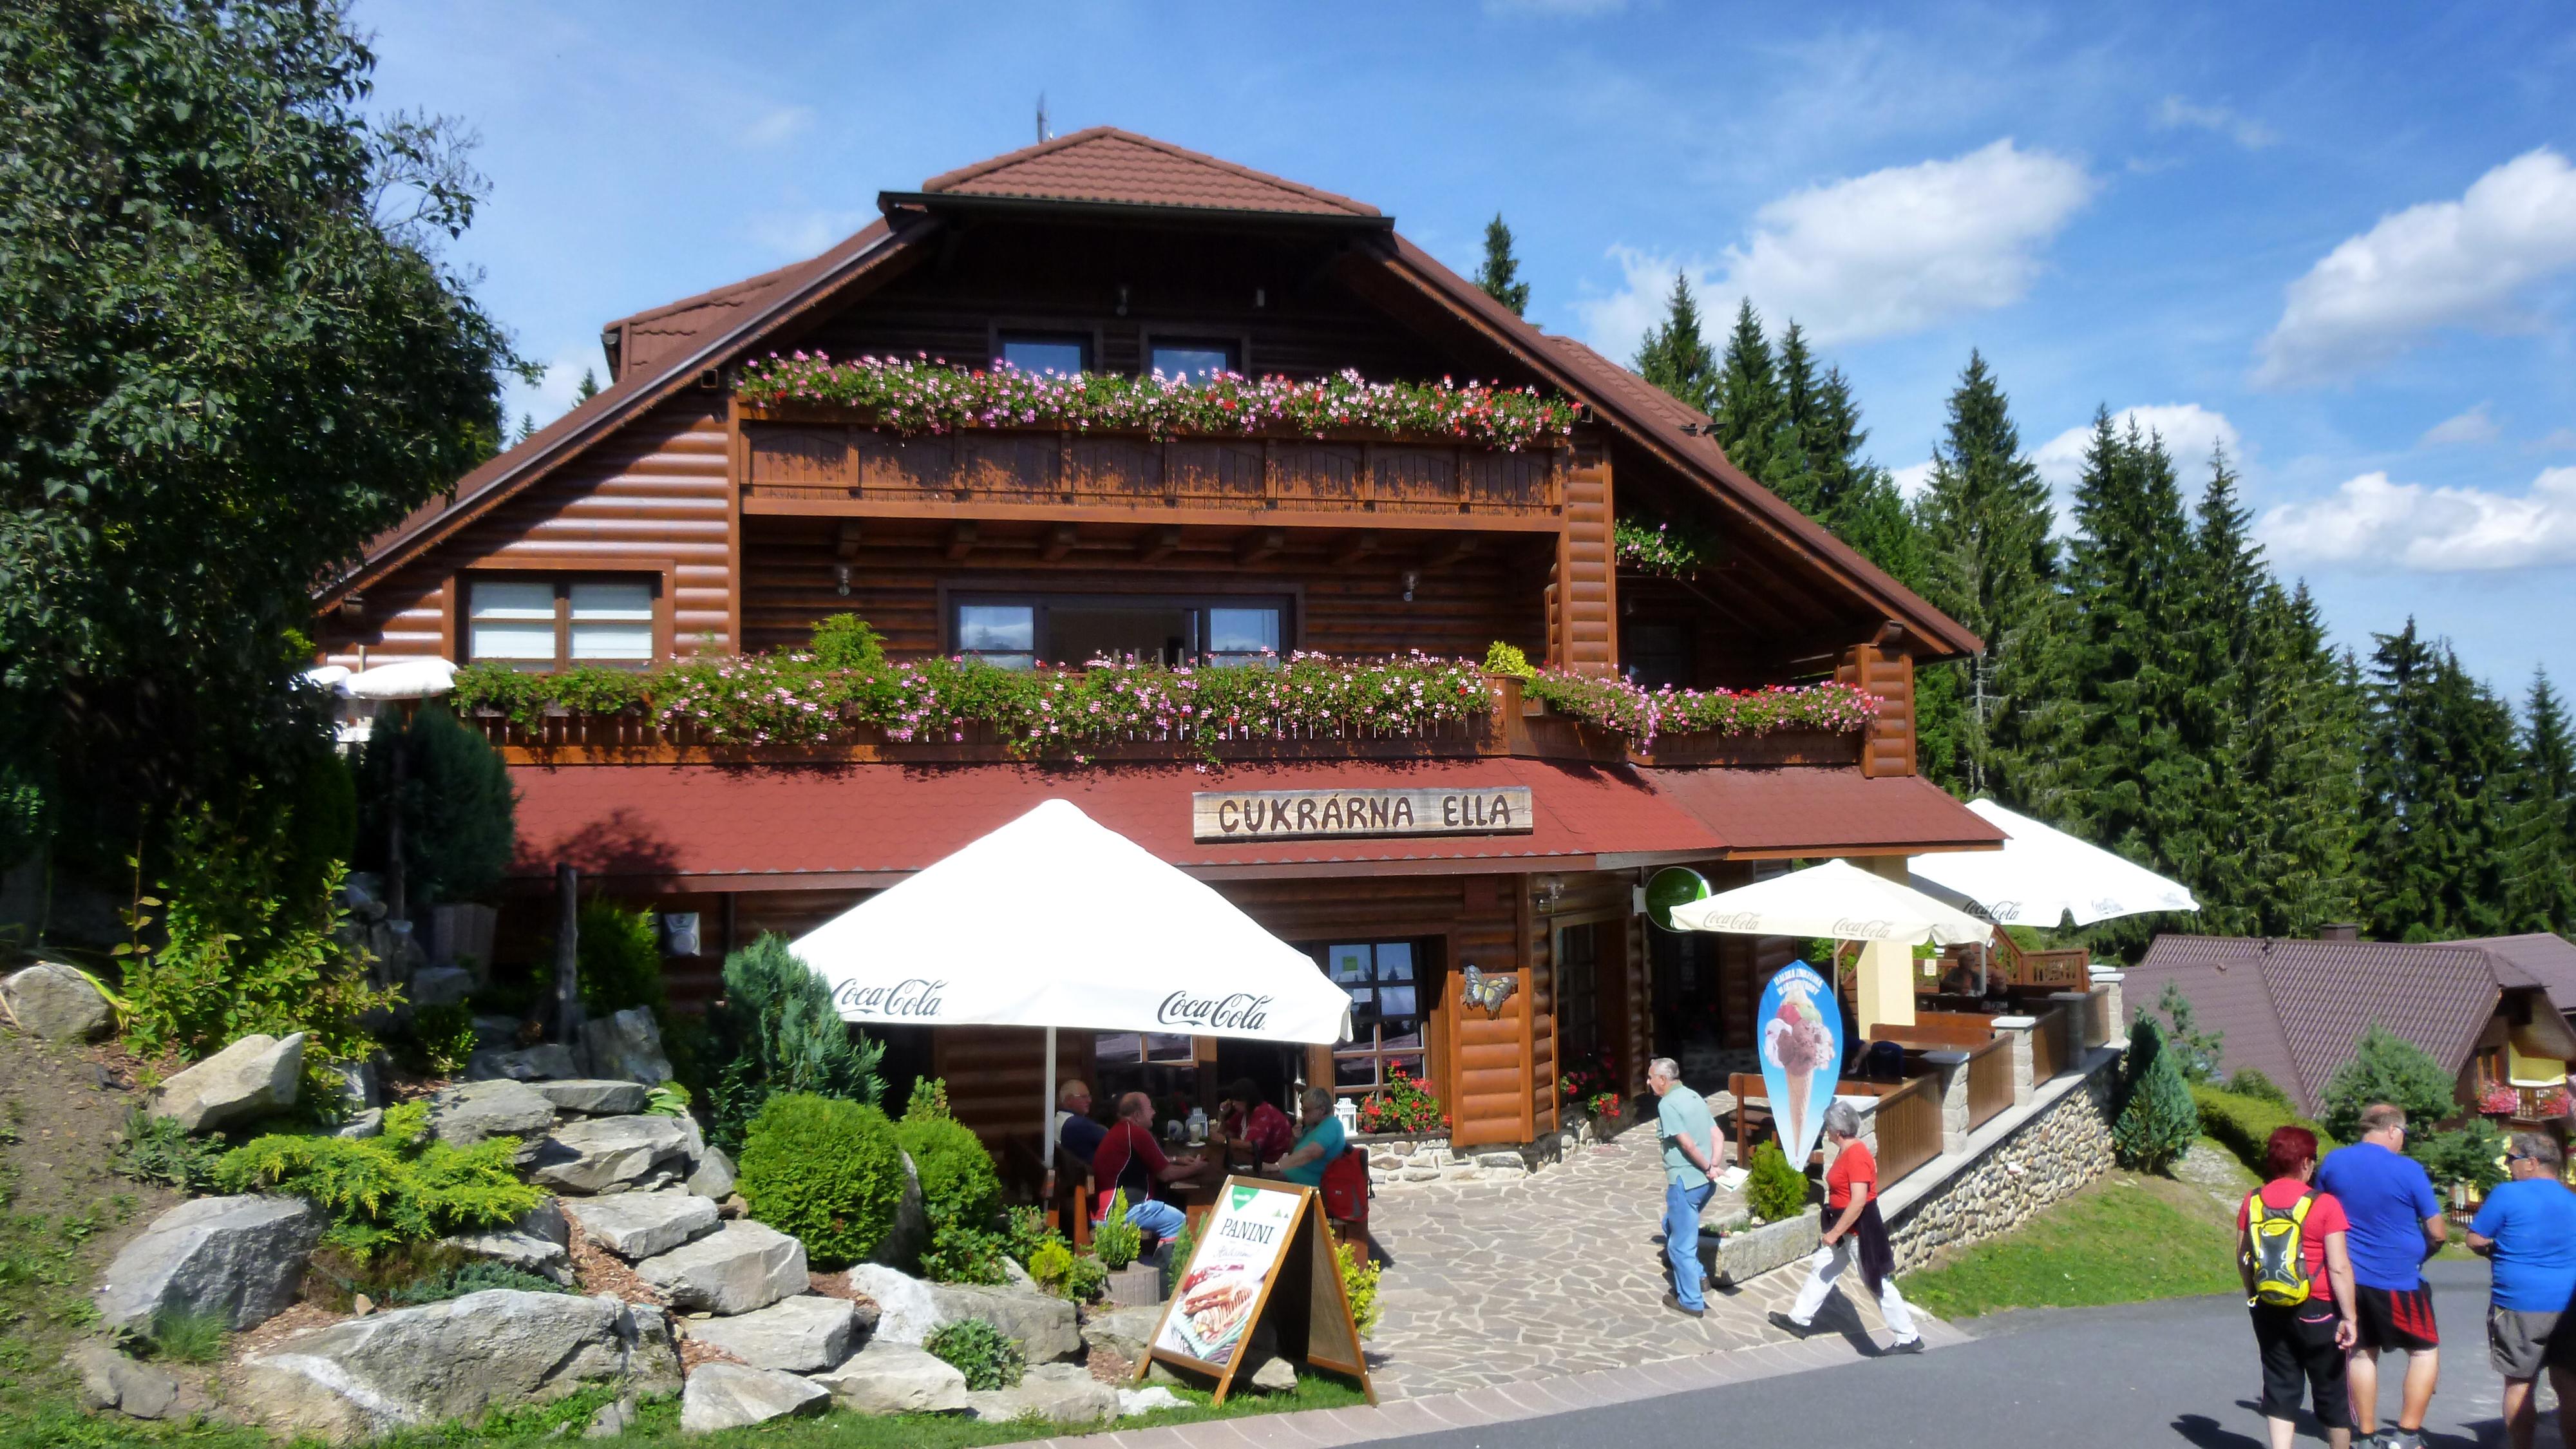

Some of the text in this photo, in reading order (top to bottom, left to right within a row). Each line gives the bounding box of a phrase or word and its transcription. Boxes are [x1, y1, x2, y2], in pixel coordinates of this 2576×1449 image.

[1219, 793, 1510, 833] CUKRÁRNA ELLA
[1157, 990, 1274, 1030] Coca-Cola
[1219, 1218, 1275, 1244] PANINI
